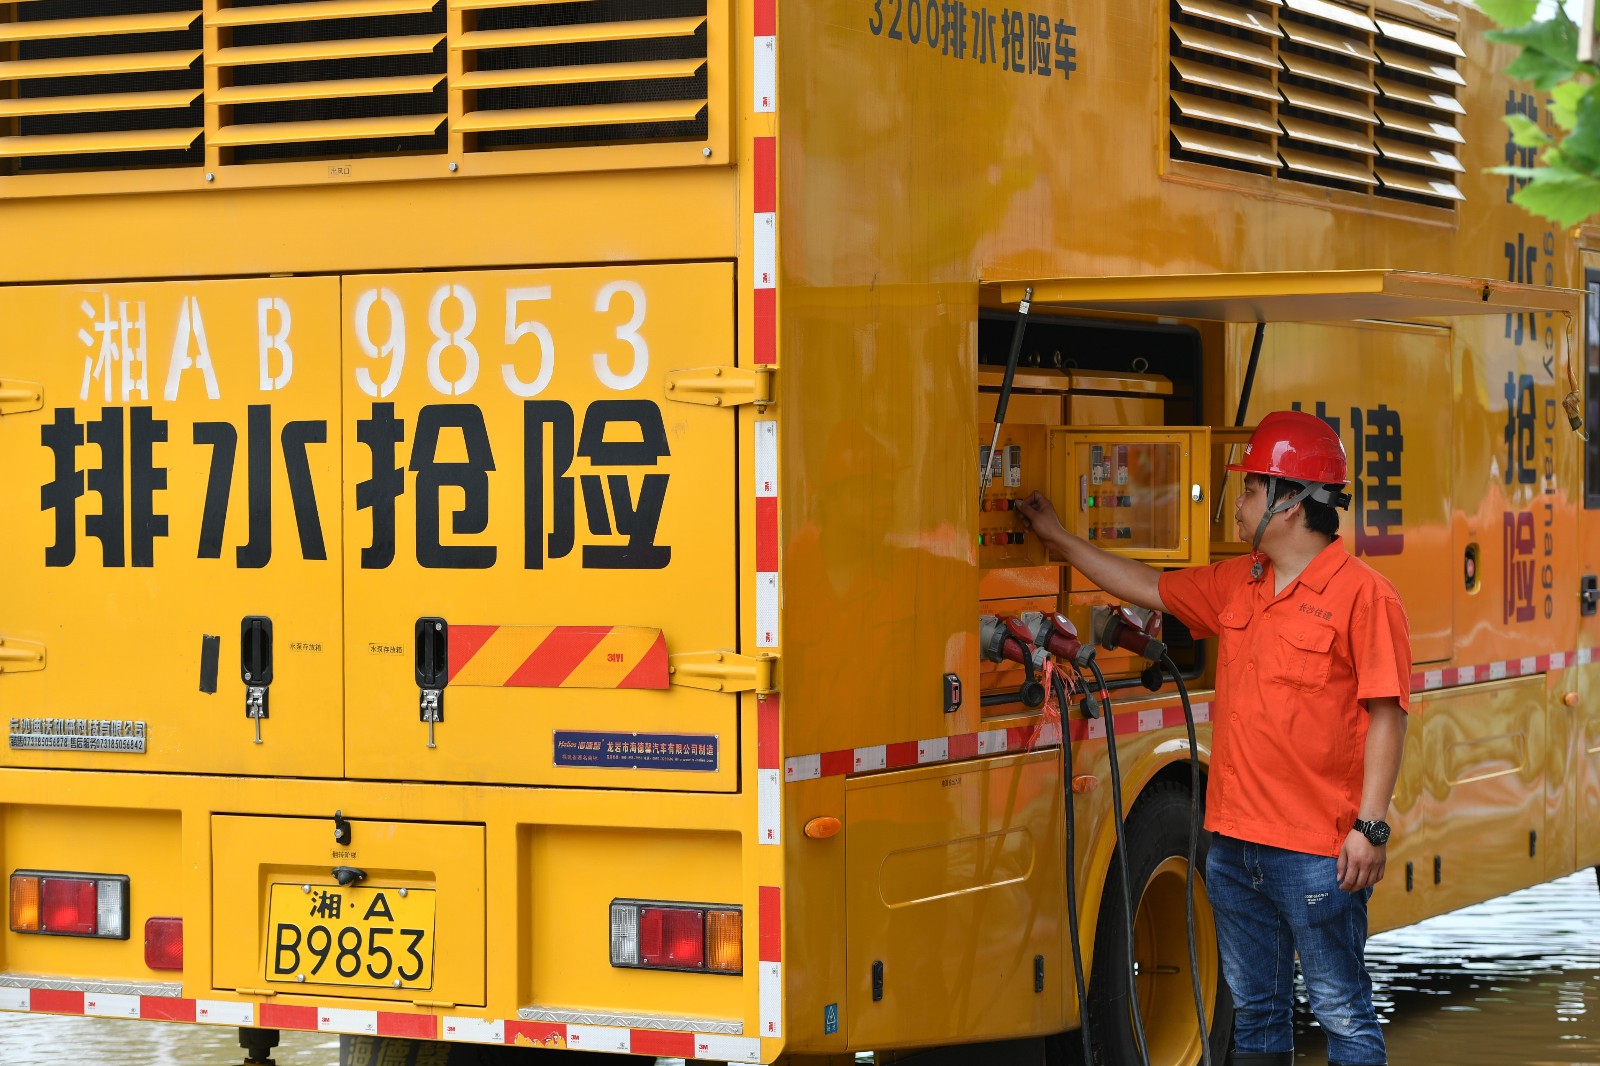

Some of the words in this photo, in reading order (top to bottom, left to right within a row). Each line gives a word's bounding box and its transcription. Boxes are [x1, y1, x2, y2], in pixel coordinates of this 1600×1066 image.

[41, 399, 671, 569] 排水抢险
[1542, 399, 1556, 619] Drainage
[607, 653, 624, 663] 3M
[607, 741, 714, 756] 龙岩市海德馨汽车有限公司制造
[274, 923, 425, 981] B9853
